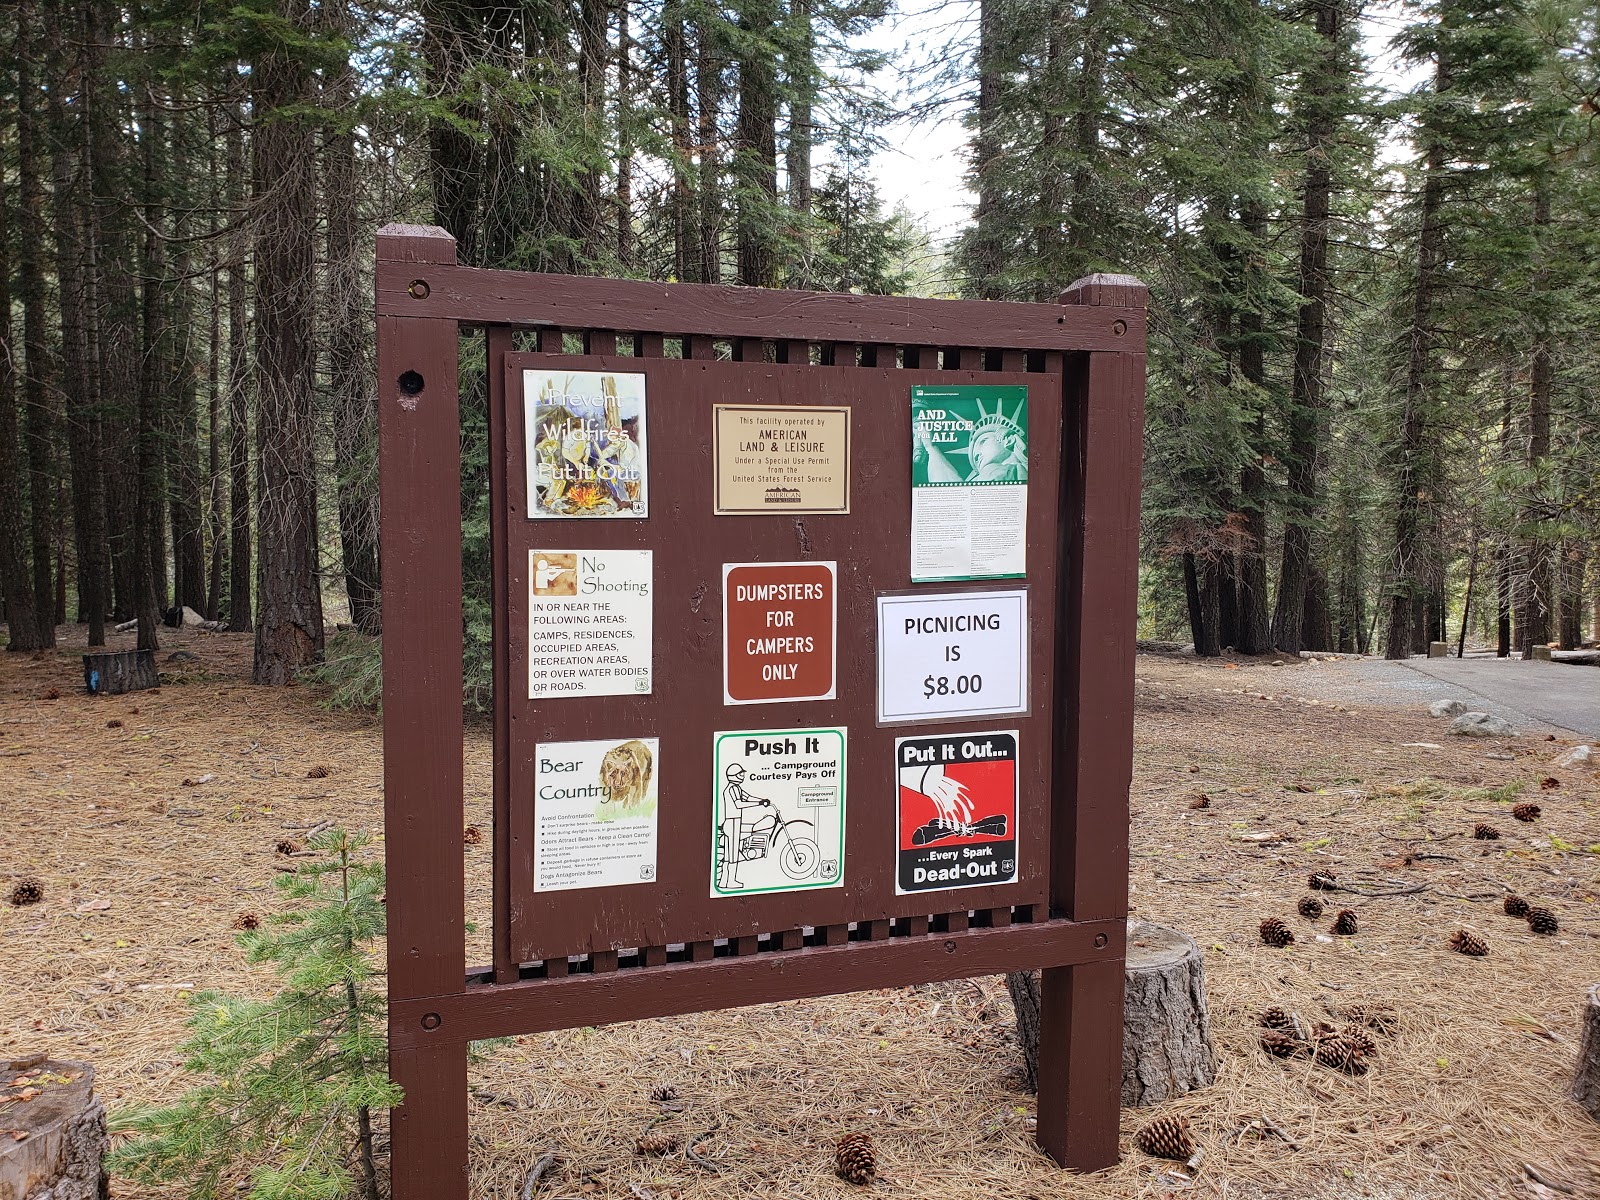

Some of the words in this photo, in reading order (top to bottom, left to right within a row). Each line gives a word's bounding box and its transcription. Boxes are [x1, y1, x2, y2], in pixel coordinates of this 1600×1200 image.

[545, 389, 623, 408] Prevent
[740, 417, 754, 425] This
[756, 417, 782, 426] facility
[785, 418, 814, 426] operated
[817, 418, 825, 427] by
[917, 410, 946, 420] AND
[542, 418, 629, 442] Wildfires
[917, 421, 973, 431] JUSTICE
[759, 430, 807, 440] AMERICAN
[931, 432, 957, 443] ALL
[740, 442, 765, 452] LAND
[770, 442, 779, 452] &
[785, 442, 825, 453] LEISURE
[765, 457, 789, 465] Special
[538, 463, 573, 480] Put
[578, 463, 593, 480] It
[597, 463, 639, 480] Out
[732, 475, 755, 483] United
[757, 475, 780, 483] States
[582, 556, 606, 573] No
[581, 577, 649, 596] Shooting
[736, 584, 823, 602] DUMPSTERS
[533, 603, 544, 611] IN
[546, 603, 561, 611] OR
[563, 603, 590, 611] NEAR
[592, 603, 611, 611] THE
[533, 616, 590, 624] FOLLOWING
[592, 615, 627, 624] AREAS:
[766, 611, 794, 628] FOR
[905, 614, 1000, 634] PICNICING
[533, 632, 571, 641] CAMPS,
[573, 630, 635, 639] RESIDENCES,
[533, 644, 582, 653] OCCUPIED
[584, 643, 619, 652] AREAS,
[746, 637, 814, 655] CAMPERS
[945, 645, 961, 662] IS
[533, 656, 593, 665] RECREATION
[596, 656, 630, 664] AREAS,
[550, 670, 576, 678] OVER
[578, 669, 611, 677] WATER
[614, 668, 649, 676] BODIES
[762, 664, 798, 681] ONLY
[550, 682, 586, 691] ROADS.
[923, 674, 983, 699] $8.00
[744, 738, 797, 756] Push
[805, 737, 820, 754] It
[904, 745, 935, 763] Put
[941, 744, 956, 760] It
[961, 741, 1008, 759] Out...
[540, 759, 583, 774] Bear
[774, 760, 836, 771] Campground
[749, 771, 792, 781] Courtesy
[795, 771, 818, 780] Pays
[821, 770, 836, 778] Off
[539, 784, 612, 804] Country
[917, 850, 959, 862] ...Every
[963, 846, 993, 859] Spark
[913, 861, 998, 883] Dead-Out
